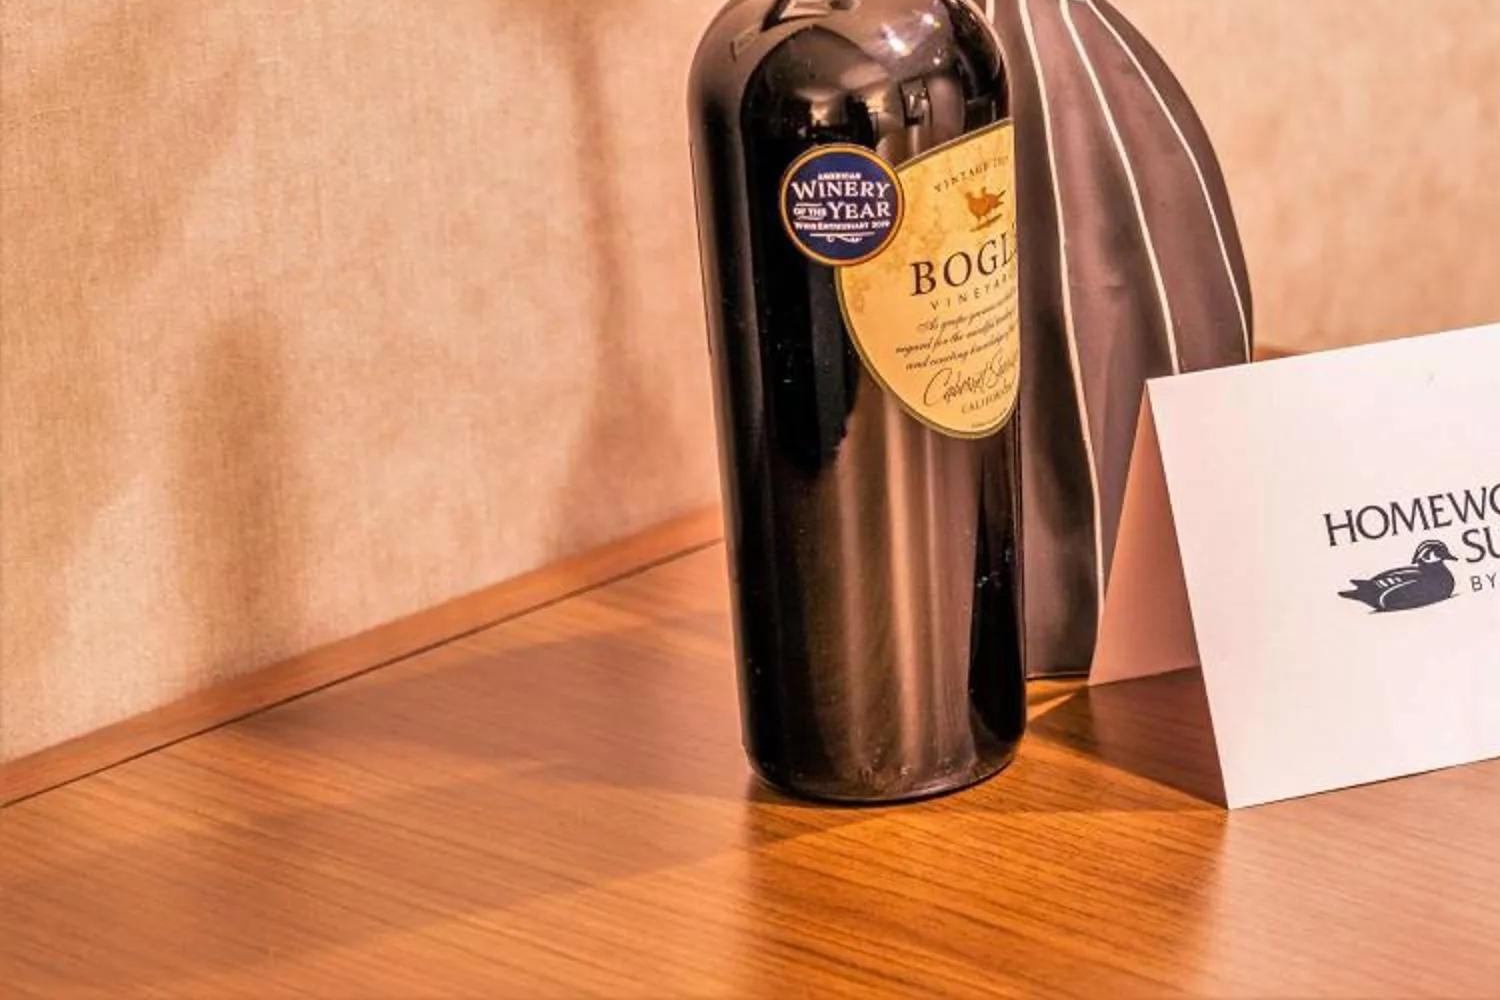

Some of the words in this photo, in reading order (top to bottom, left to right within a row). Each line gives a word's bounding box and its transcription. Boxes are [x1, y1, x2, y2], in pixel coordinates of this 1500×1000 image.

[790, 180, 891, 200] WINERY
[793, 207, 807, 216] OF
[808, 207, 827, 217] THE
[826, 201, 892, 219] YEAR
[1470, 573, 1498, 592] BY
